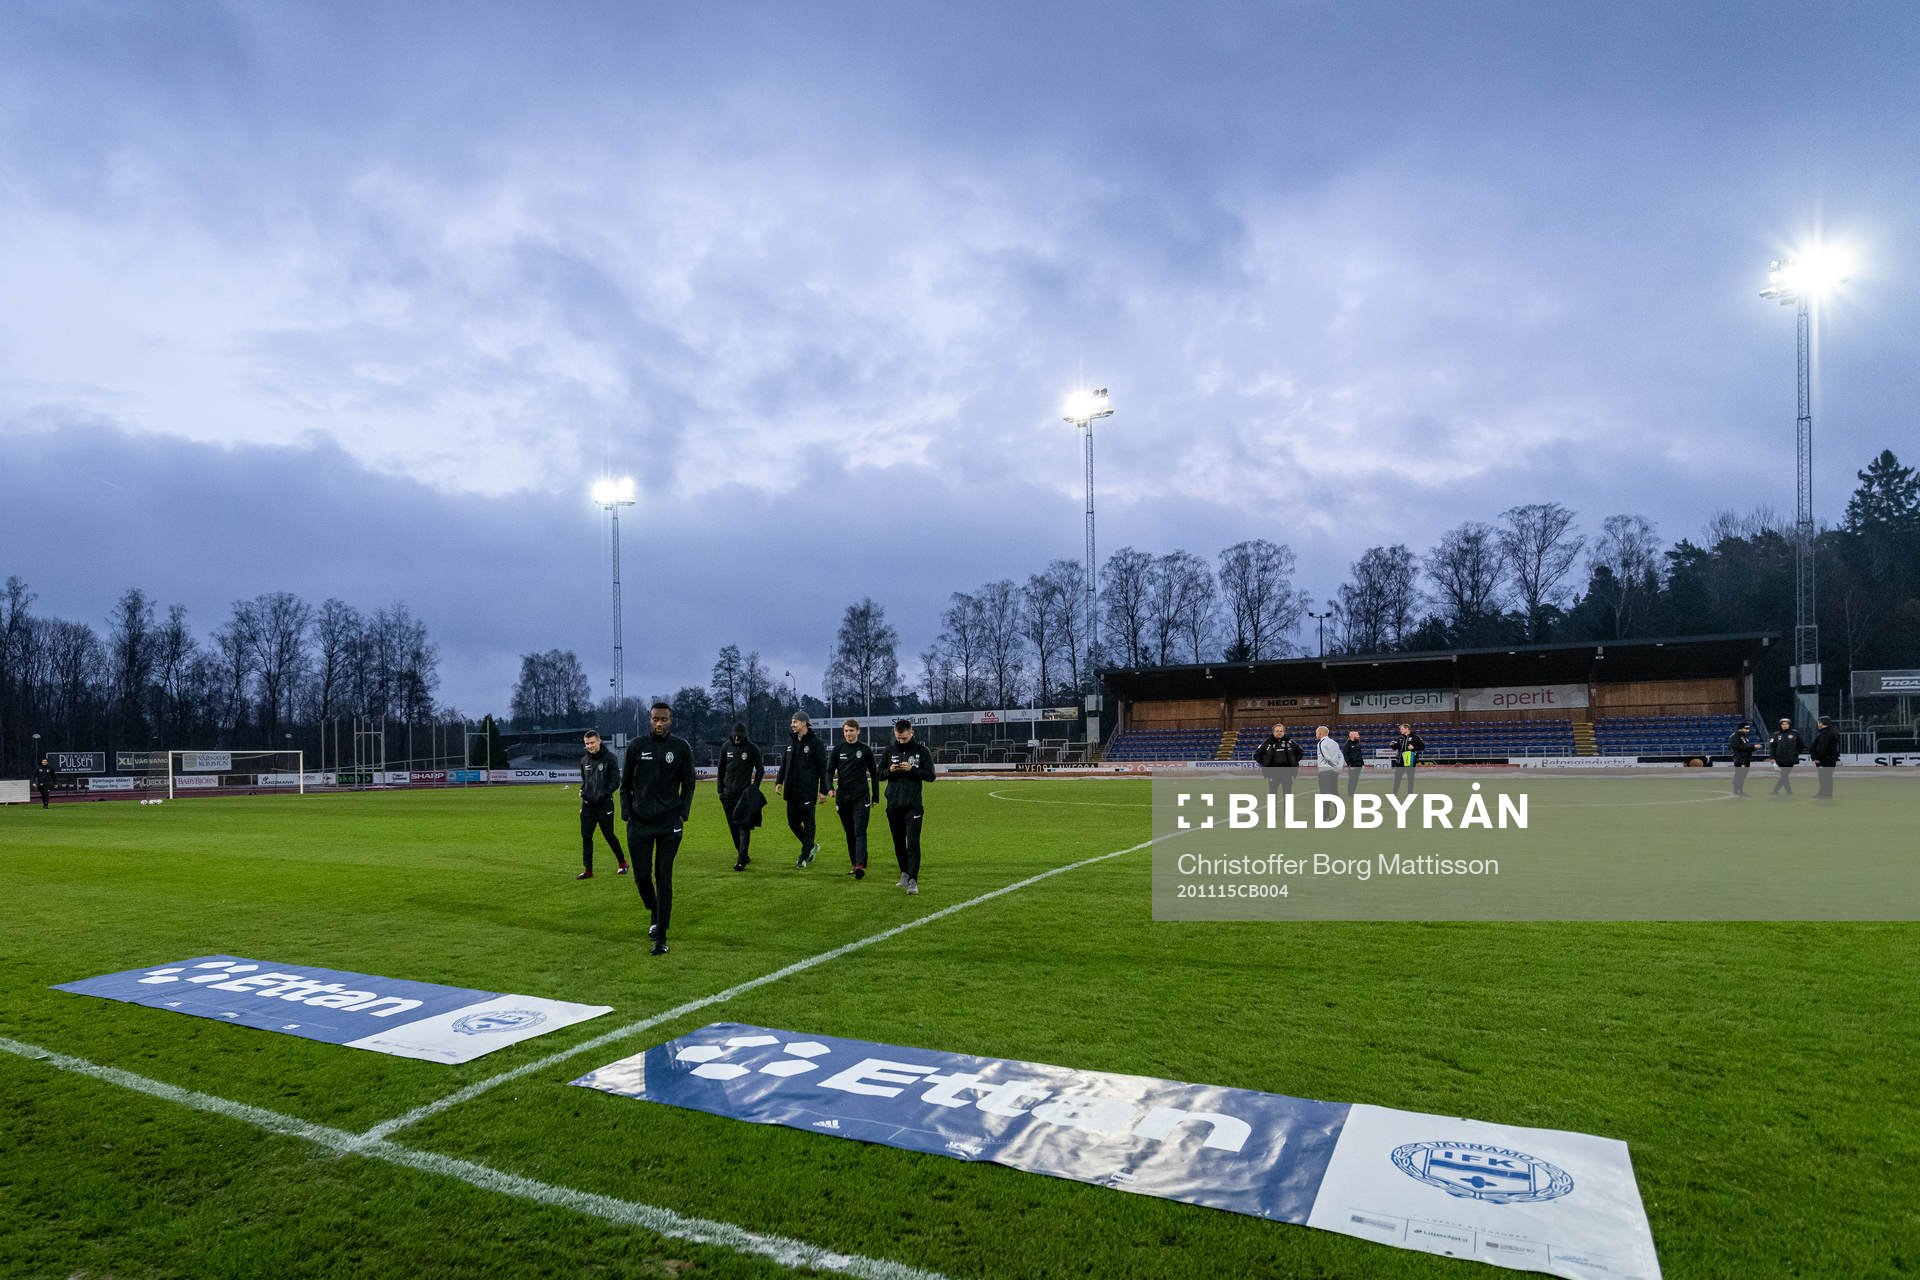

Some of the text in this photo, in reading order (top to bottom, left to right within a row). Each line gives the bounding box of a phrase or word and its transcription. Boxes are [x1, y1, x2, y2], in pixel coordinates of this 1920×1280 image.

[1493, 689, 1555, 708] aperit
[892, 716, 928, 725] stium
[118, 757, 133, 766] XL
[411, 772, 445, 780] SHARP
[206, 972, 424, 1018] Ettan
[816, 1057, 1252, 1153] Ettan
[1444, 1151, 1515, 1169] IFK
